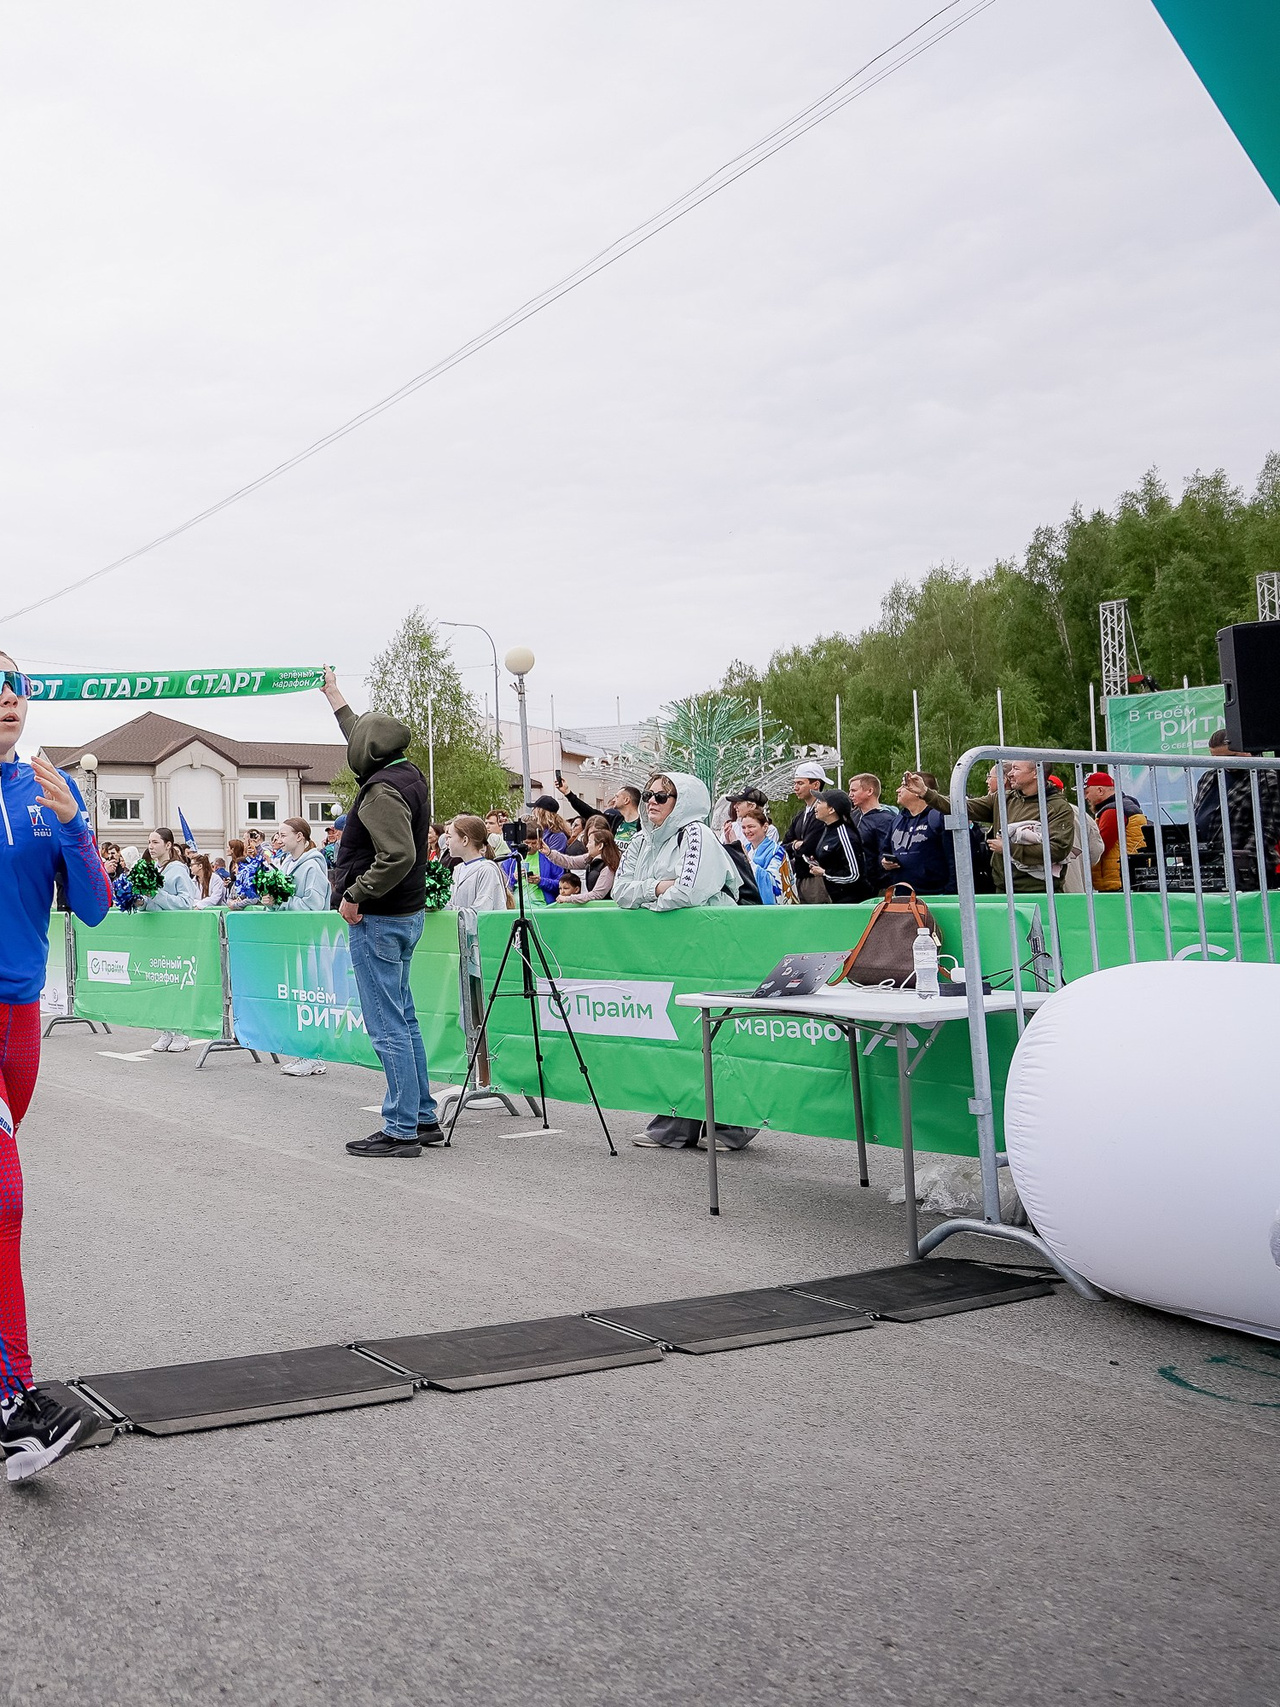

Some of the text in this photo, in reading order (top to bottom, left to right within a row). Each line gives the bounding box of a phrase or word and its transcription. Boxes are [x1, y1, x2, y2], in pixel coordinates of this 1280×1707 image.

[185, 671, 266, 695] СТАРТ
[278, 669, 315, 680] зелёный
[81, 676, 170, 699] СТАРТ
[272, 678, 310, 689] марафон
[1129, 705, 1196, 722] В твоём
[101, 960, 125, 975] Прайм
[149, 955, 182, 970] зелёный
[277, 983, 336, 1004] В твоём
[576, 995, 653, 1023] Прайм
